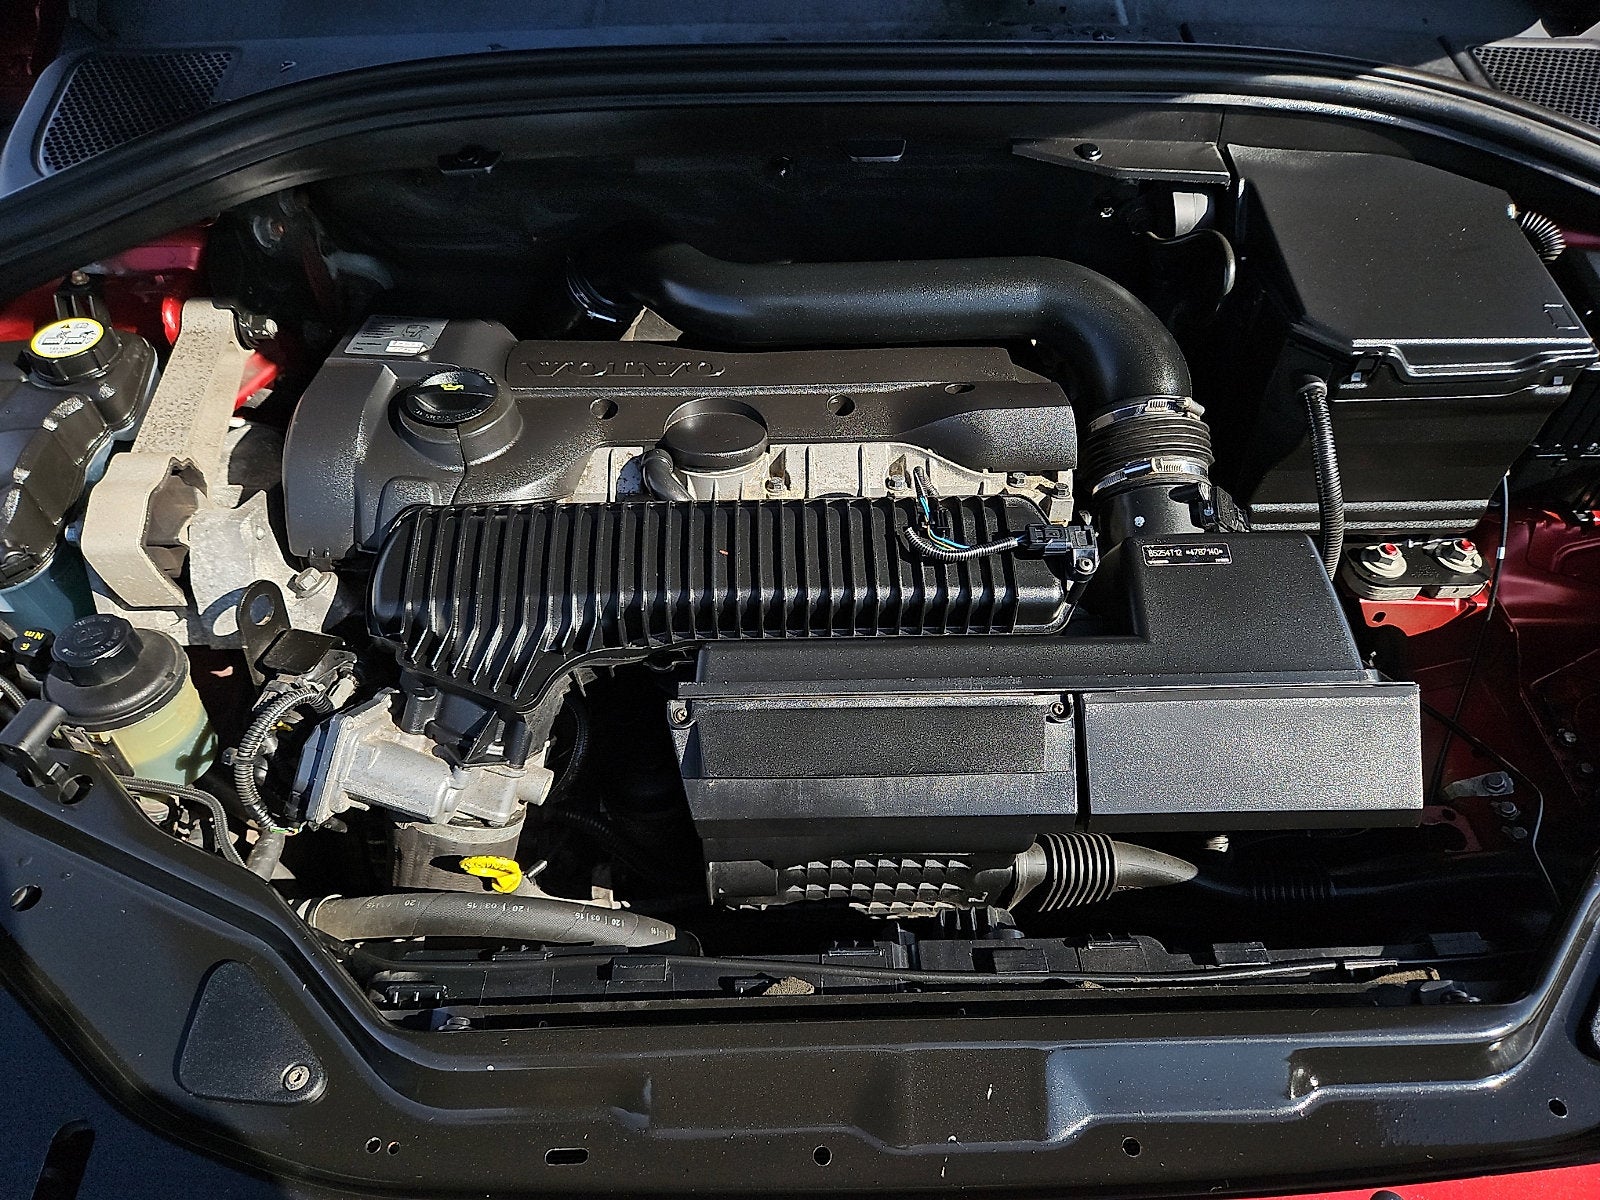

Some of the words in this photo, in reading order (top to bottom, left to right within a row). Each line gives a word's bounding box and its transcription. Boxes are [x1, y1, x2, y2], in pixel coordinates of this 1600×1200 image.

[519, 362, 726, 377] VOLVO
[23, 630, 45, 640] Nm
[512, 904, 525, 912] 20
[611, 918, 622, 927] 20
